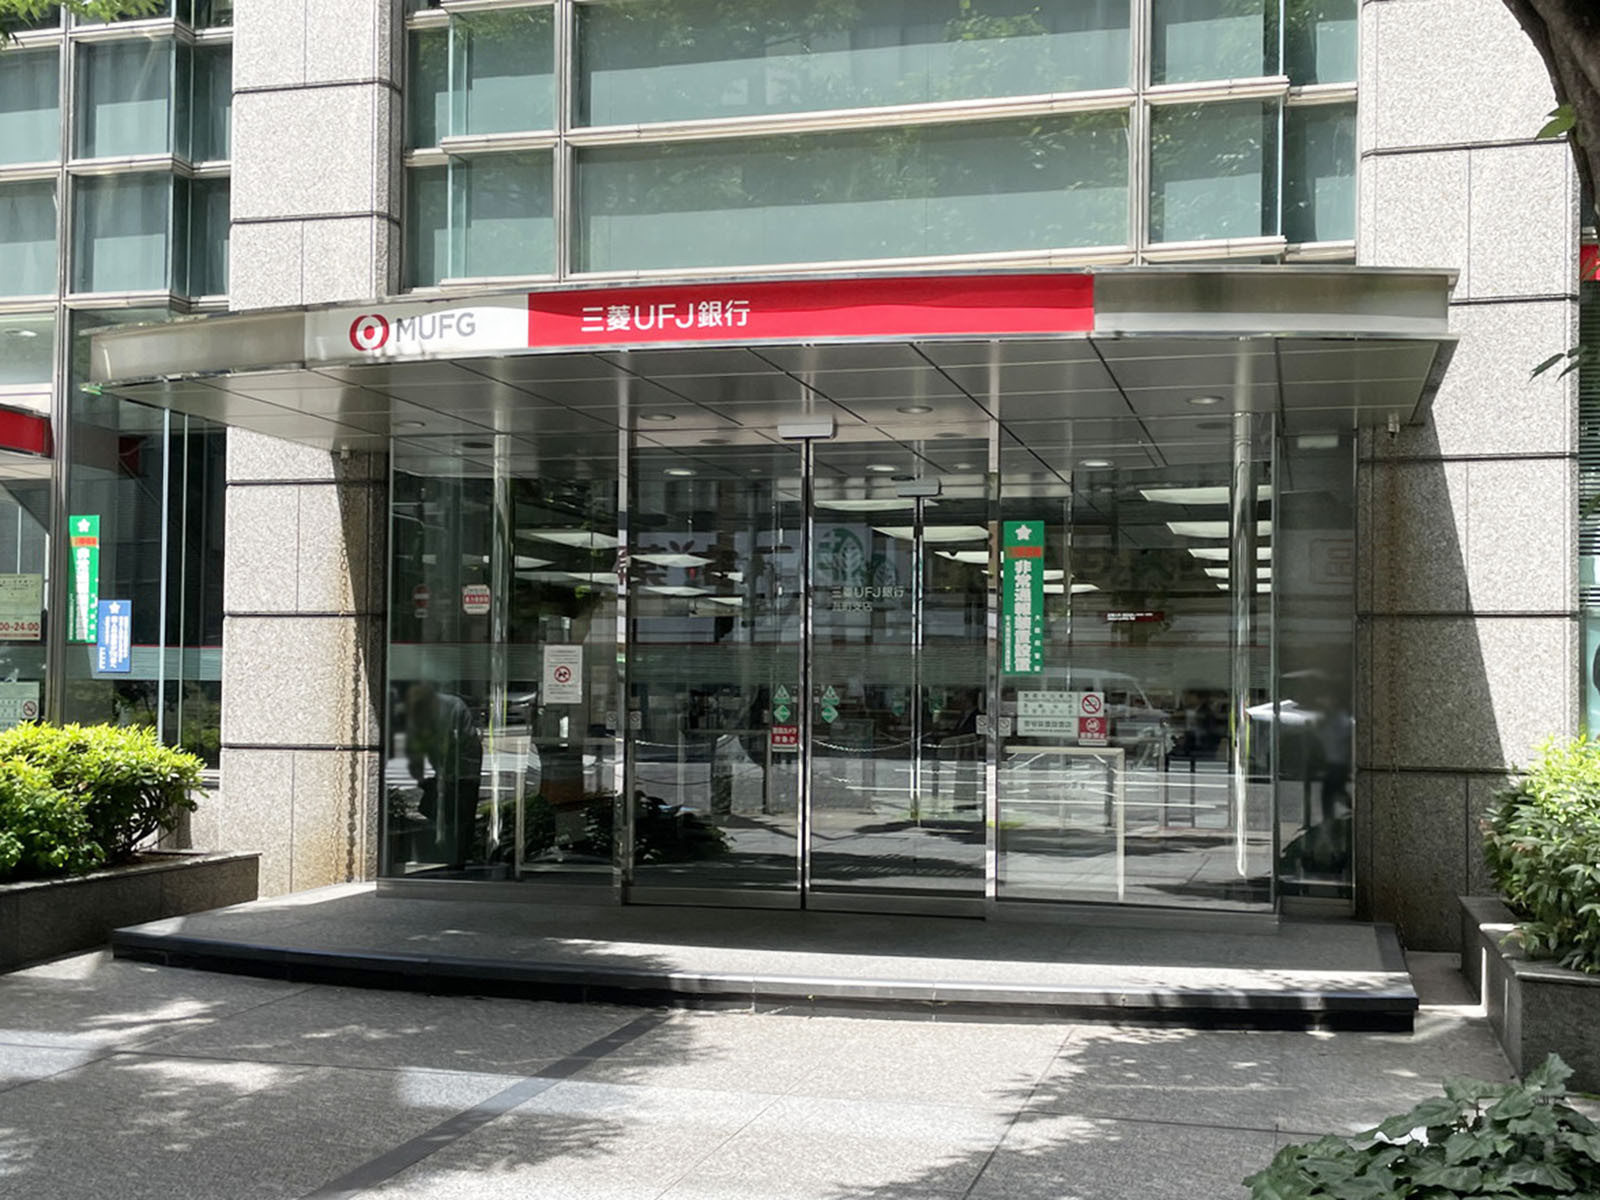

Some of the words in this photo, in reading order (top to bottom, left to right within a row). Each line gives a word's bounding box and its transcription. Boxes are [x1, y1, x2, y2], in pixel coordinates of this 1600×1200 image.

[396, 312, 476, 342] MUFG
[580, 299, 750, 332] 三菱UFJ銀行
